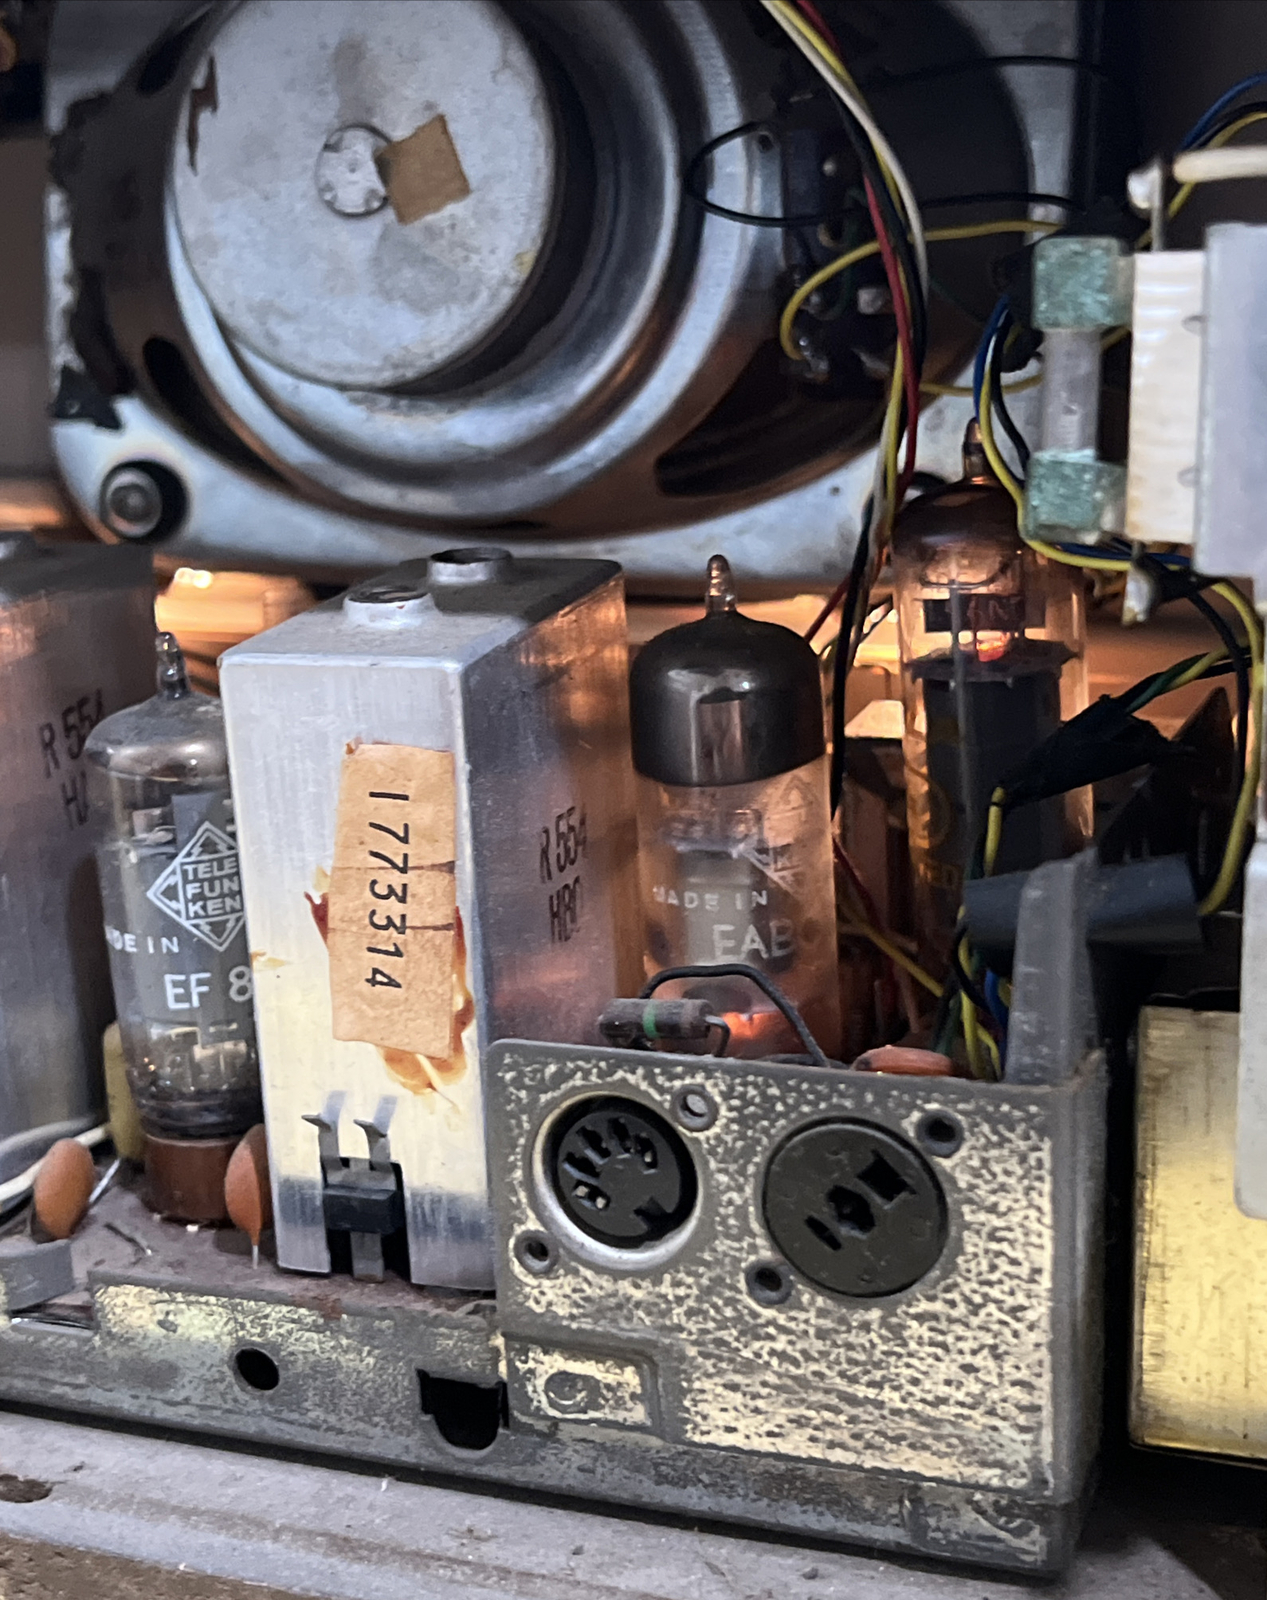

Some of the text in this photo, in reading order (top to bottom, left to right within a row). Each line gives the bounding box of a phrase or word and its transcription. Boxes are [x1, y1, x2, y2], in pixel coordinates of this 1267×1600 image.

[38, 721, 61, 779] R
[183, 857, 238, 880] TELE
[186, 876, 240, 898] FUN
[652, 885, 768, 912] MADE IN
[189, 895, 242, 918] KEN
[146, 935, 180, 954] IN
[163, 972, 212, 1011] EF
